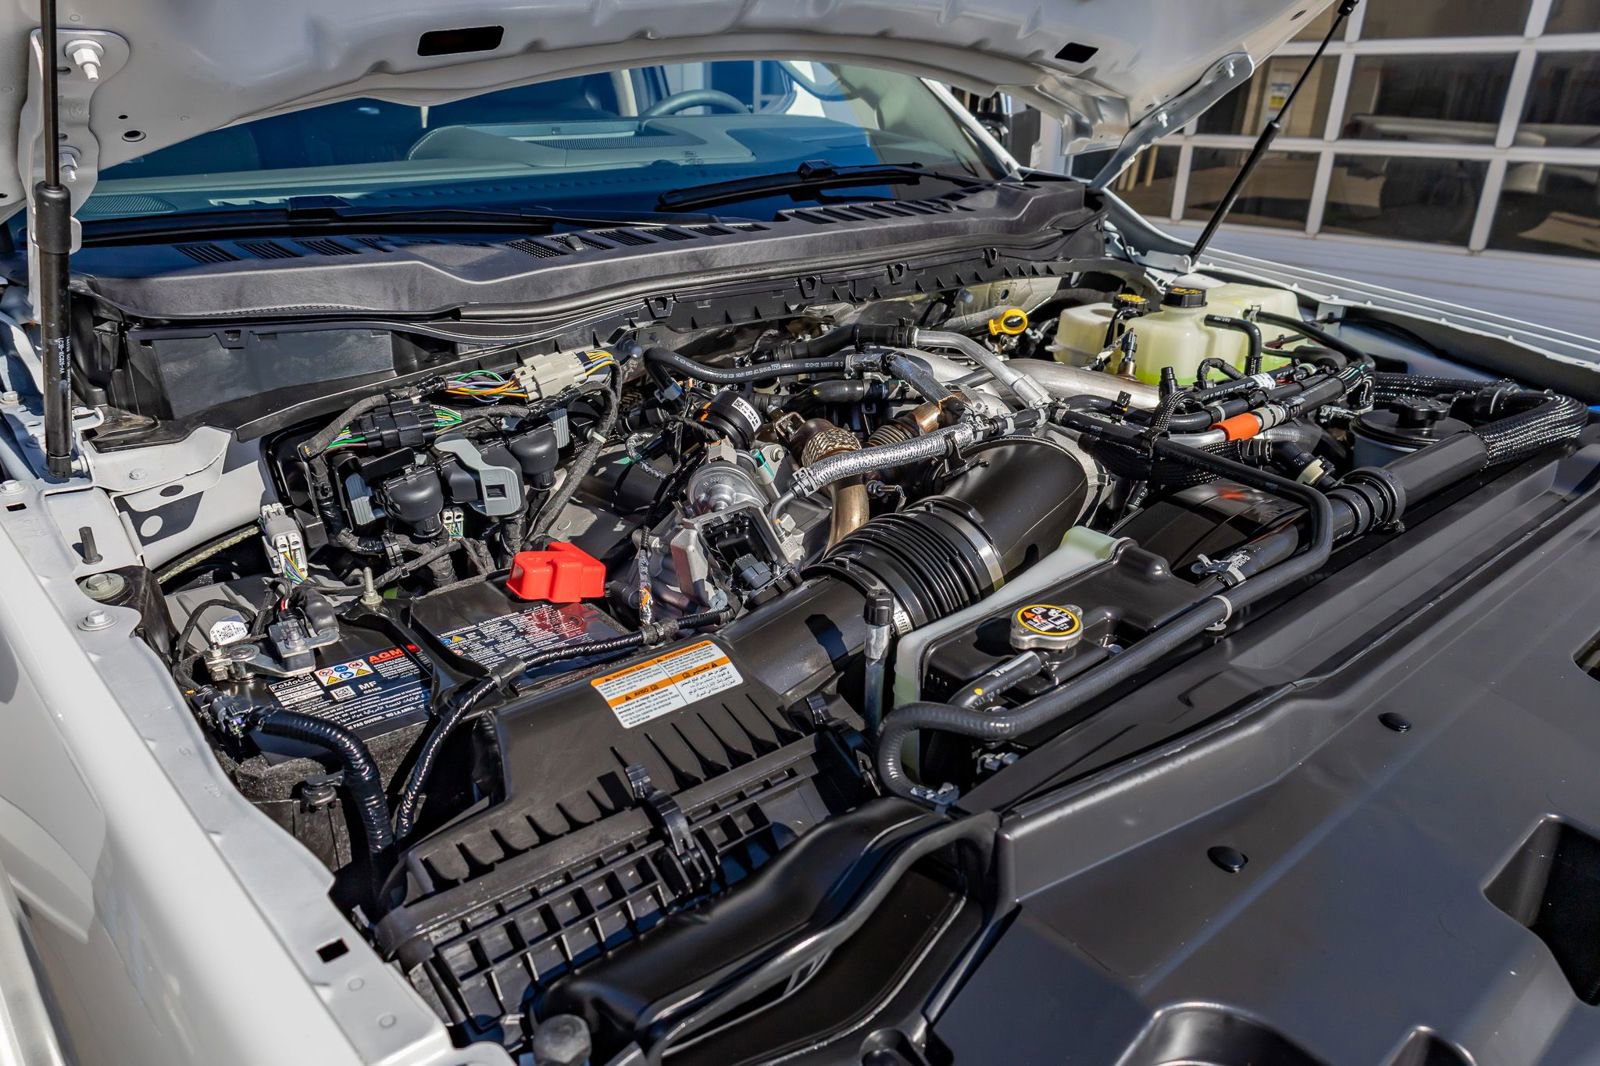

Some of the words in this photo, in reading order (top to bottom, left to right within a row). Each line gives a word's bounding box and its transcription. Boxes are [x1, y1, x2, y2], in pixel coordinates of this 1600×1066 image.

[368, 648, 402, 662] AGM
[270, 674, 312, 692] FoMoCo
[358, 681, 377, 691] MF
